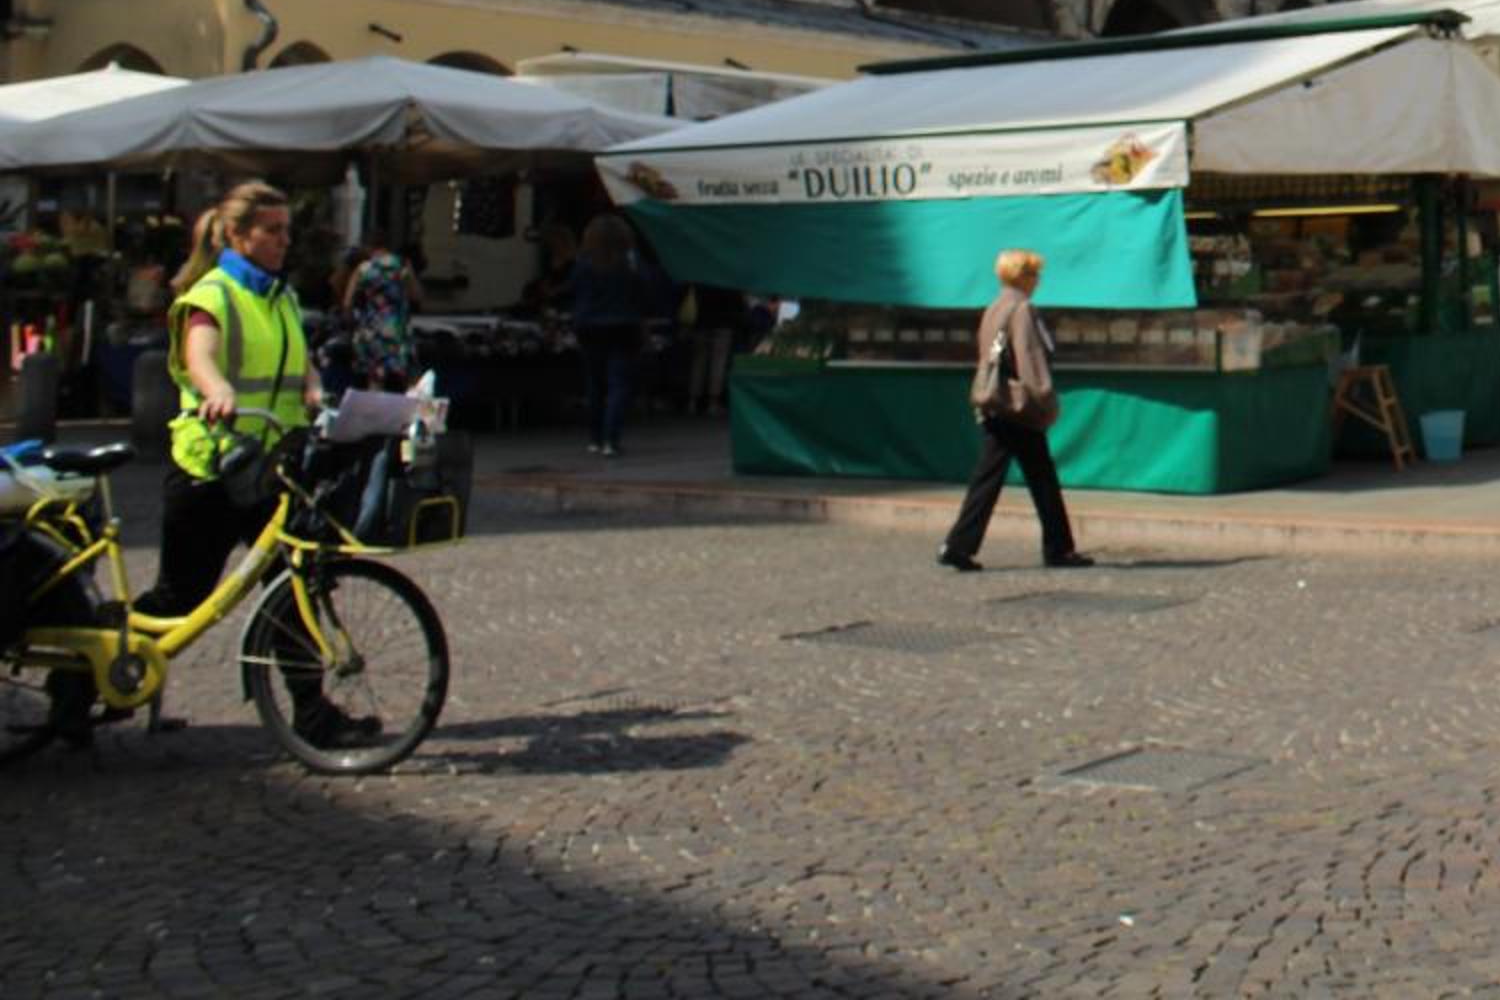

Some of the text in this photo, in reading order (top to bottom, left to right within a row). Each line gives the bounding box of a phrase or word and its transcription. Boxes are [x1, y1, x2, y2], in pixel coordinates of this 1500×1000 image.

[947, 162, 1063, 192] spezie e aromi
